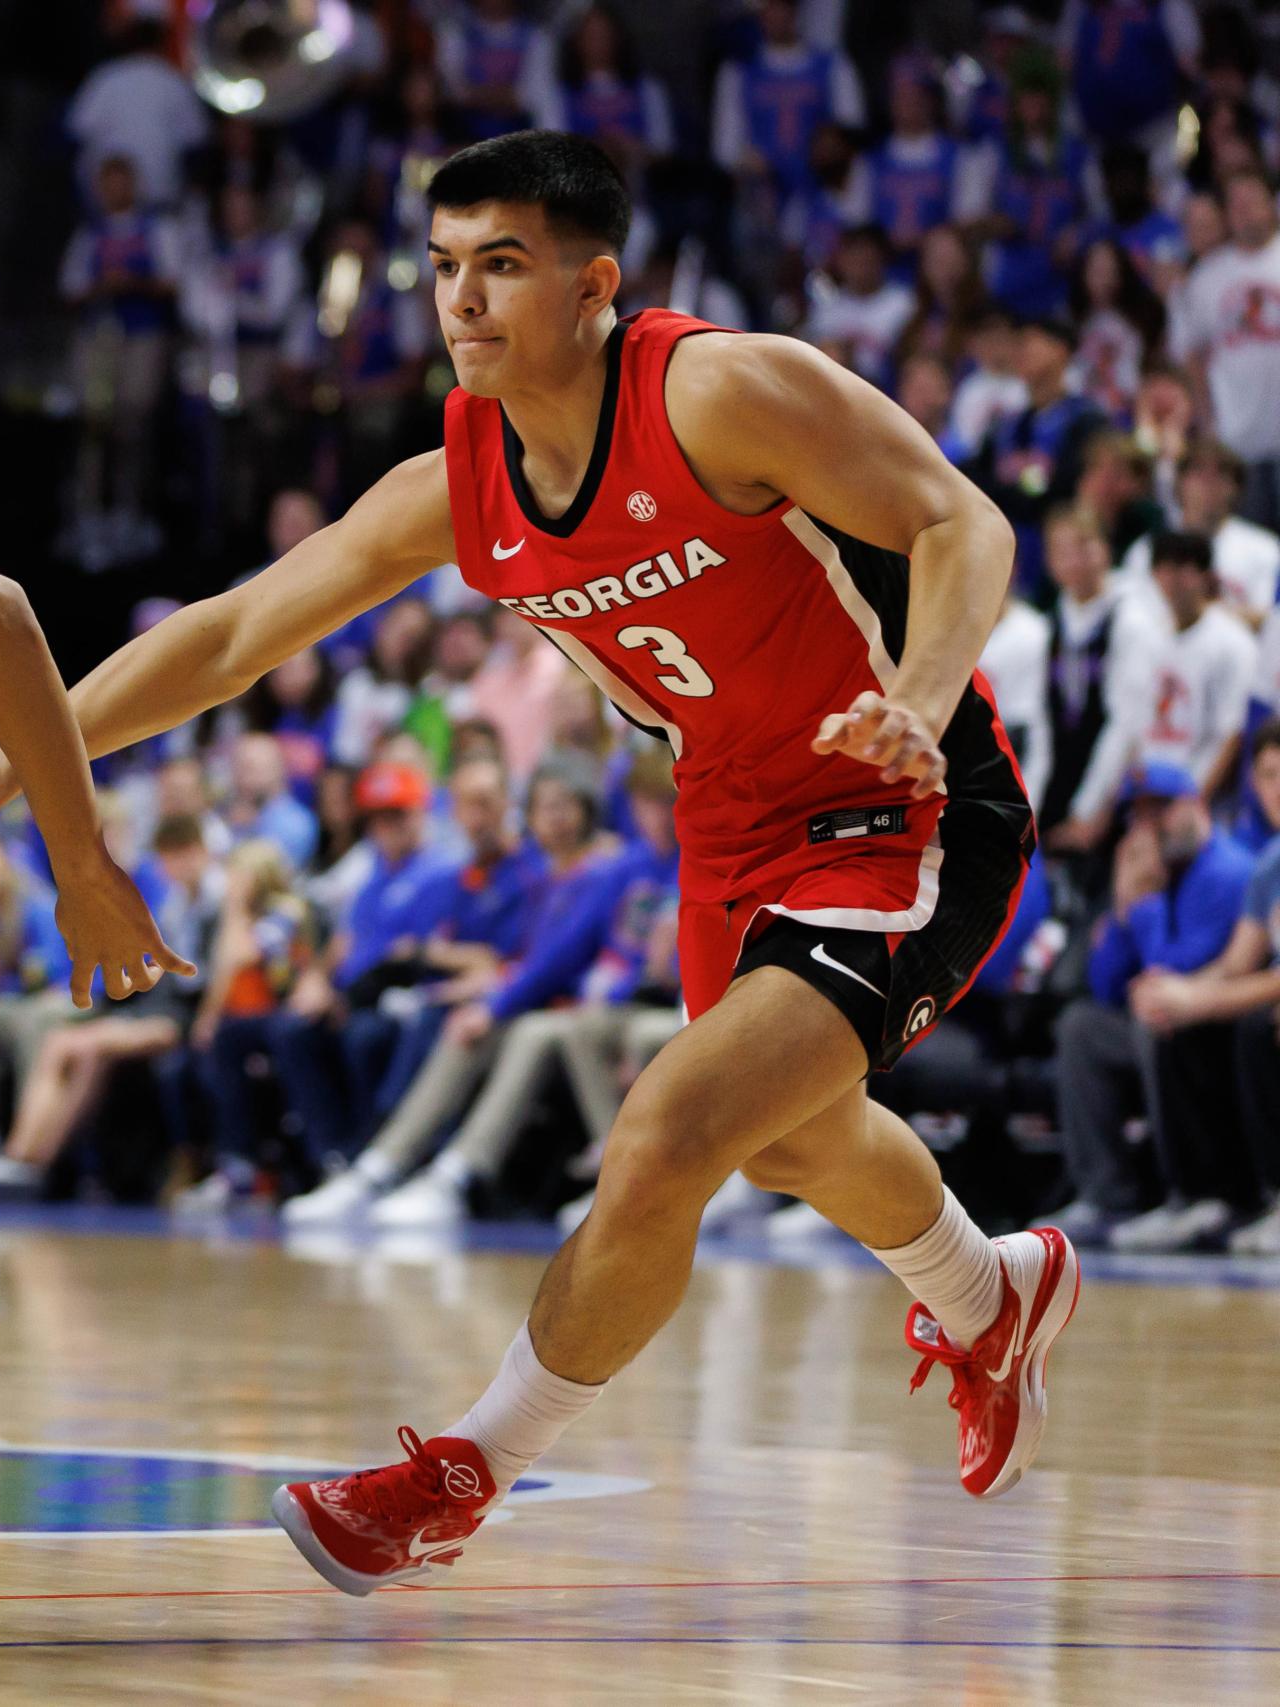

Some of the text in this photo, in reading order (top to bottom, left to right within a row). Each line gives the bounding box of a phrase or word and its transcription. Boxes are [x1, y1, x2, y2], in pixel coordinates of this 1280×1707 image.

[629, 493, 655, 520] SEC
[497, 536, 728, 619] GEORGIA
[617, 624, 715, 698] 3
[873, 814, 890, 827] 46
